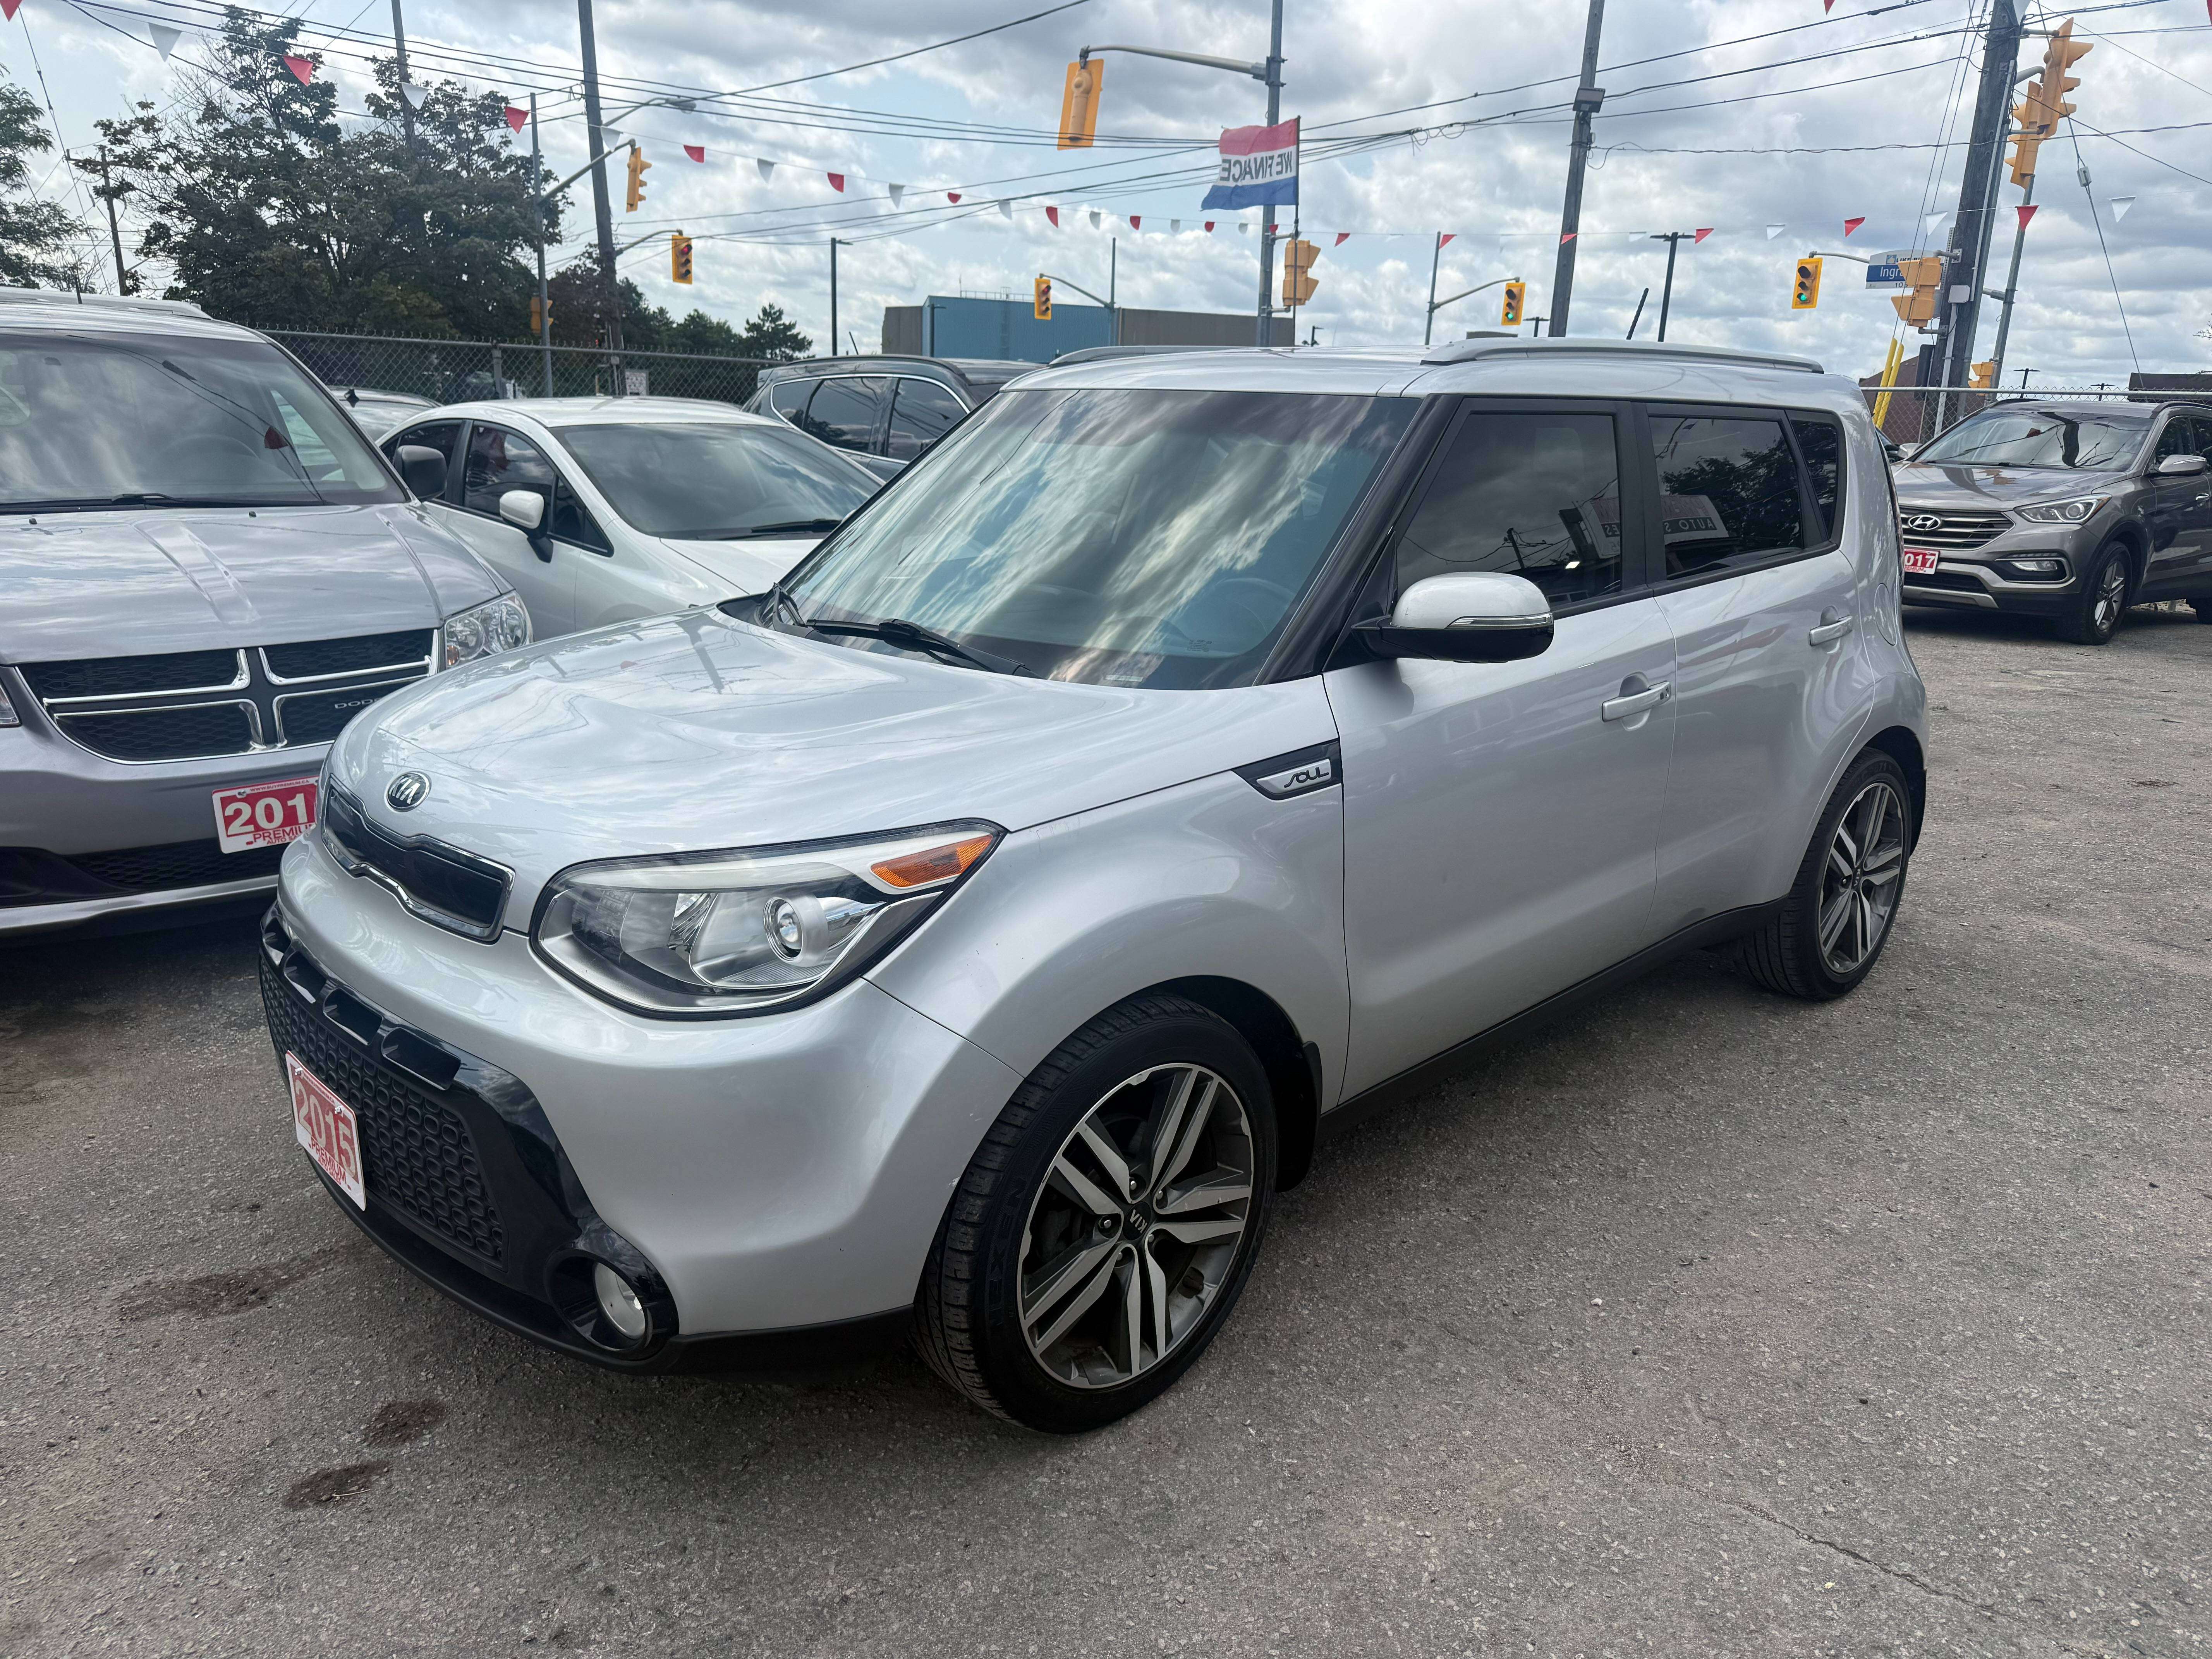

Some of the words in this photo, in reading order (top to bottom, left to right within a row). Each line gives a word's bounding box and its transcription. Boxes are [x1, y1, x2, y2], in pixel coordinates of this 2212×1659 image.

[1905, 553, 1935, 568] 017
[225, 793, 308, 835] 201
[253, 824, 313, 843] PREMIU
[295, 1080, 356, 1178] 2015
[311, 1136, 347, 1184] PREMIUM
[1130, 1209, 1147, 1233] KIA
